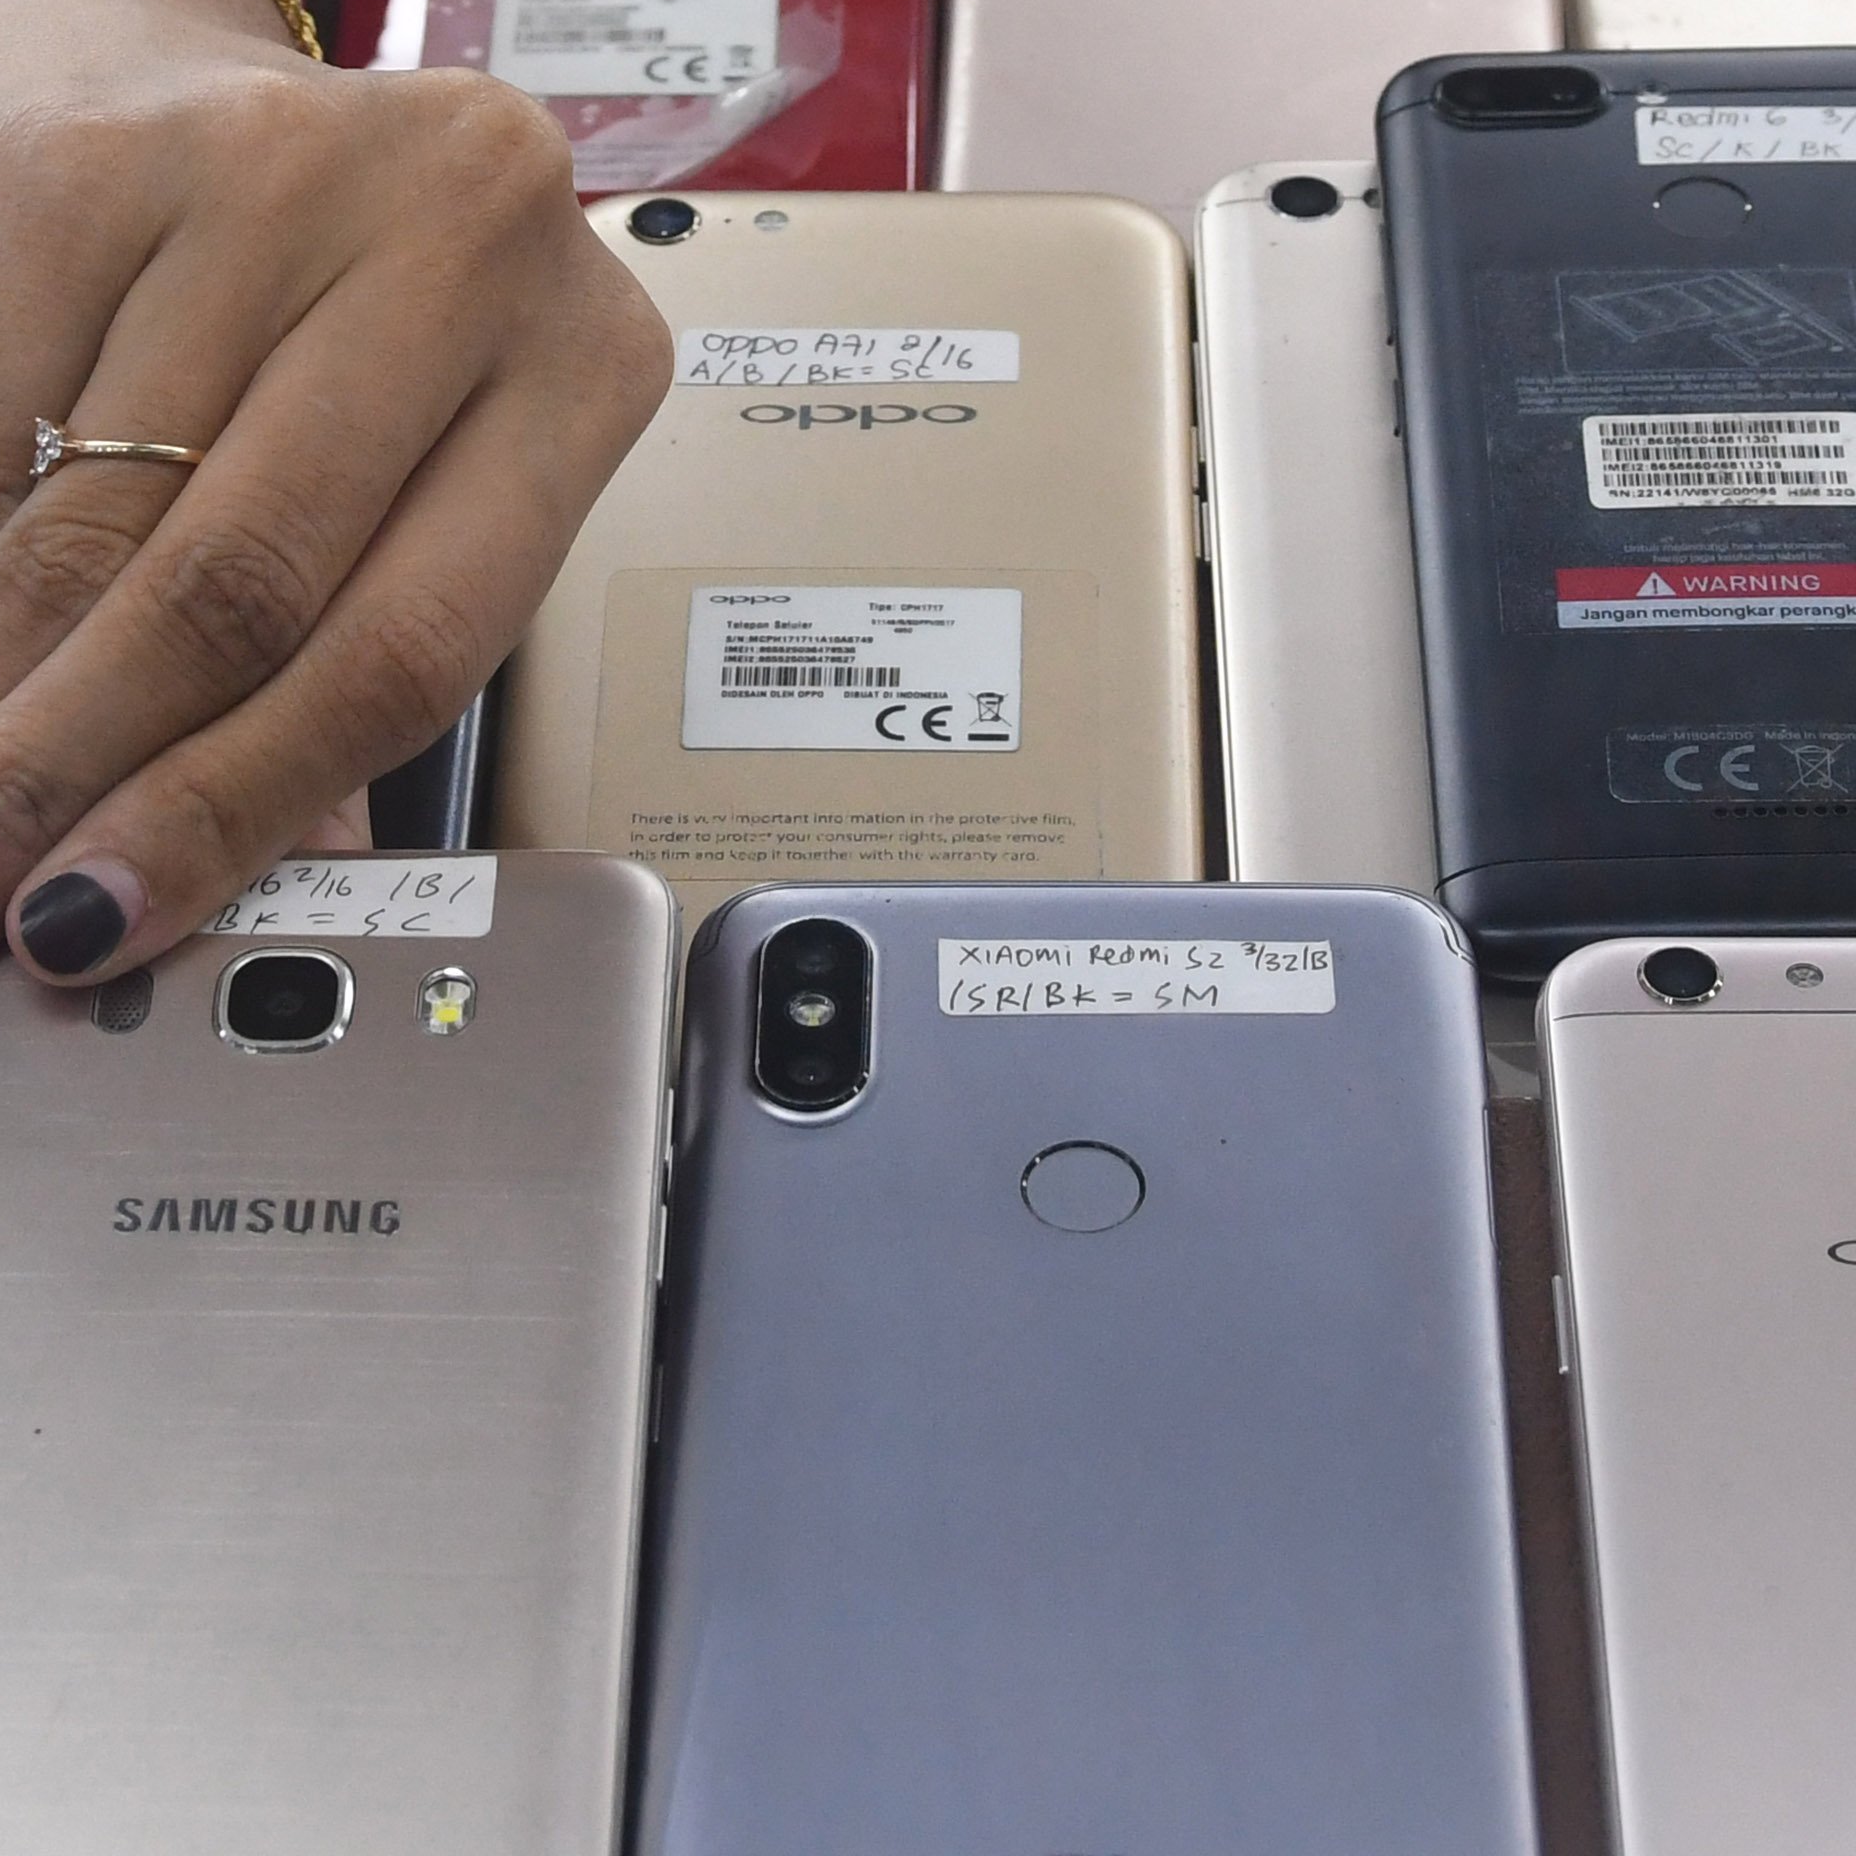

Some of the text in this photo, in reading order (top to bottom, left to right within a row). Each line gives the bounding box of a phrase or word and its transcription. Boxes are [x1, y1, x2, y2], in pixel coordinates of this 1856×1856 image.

[740, 404, 977, 430] oppo
[1683, 574, 1821, 592] WARNING
[709, 595, 791, 605] oppo
[1580, 607, 1648, 622] Jangan
[1652, 604, 1775, 621] membongkar
[813, 813, 905, 825] infomation
[113, 1198, 401, 1234] SAMSUNG
